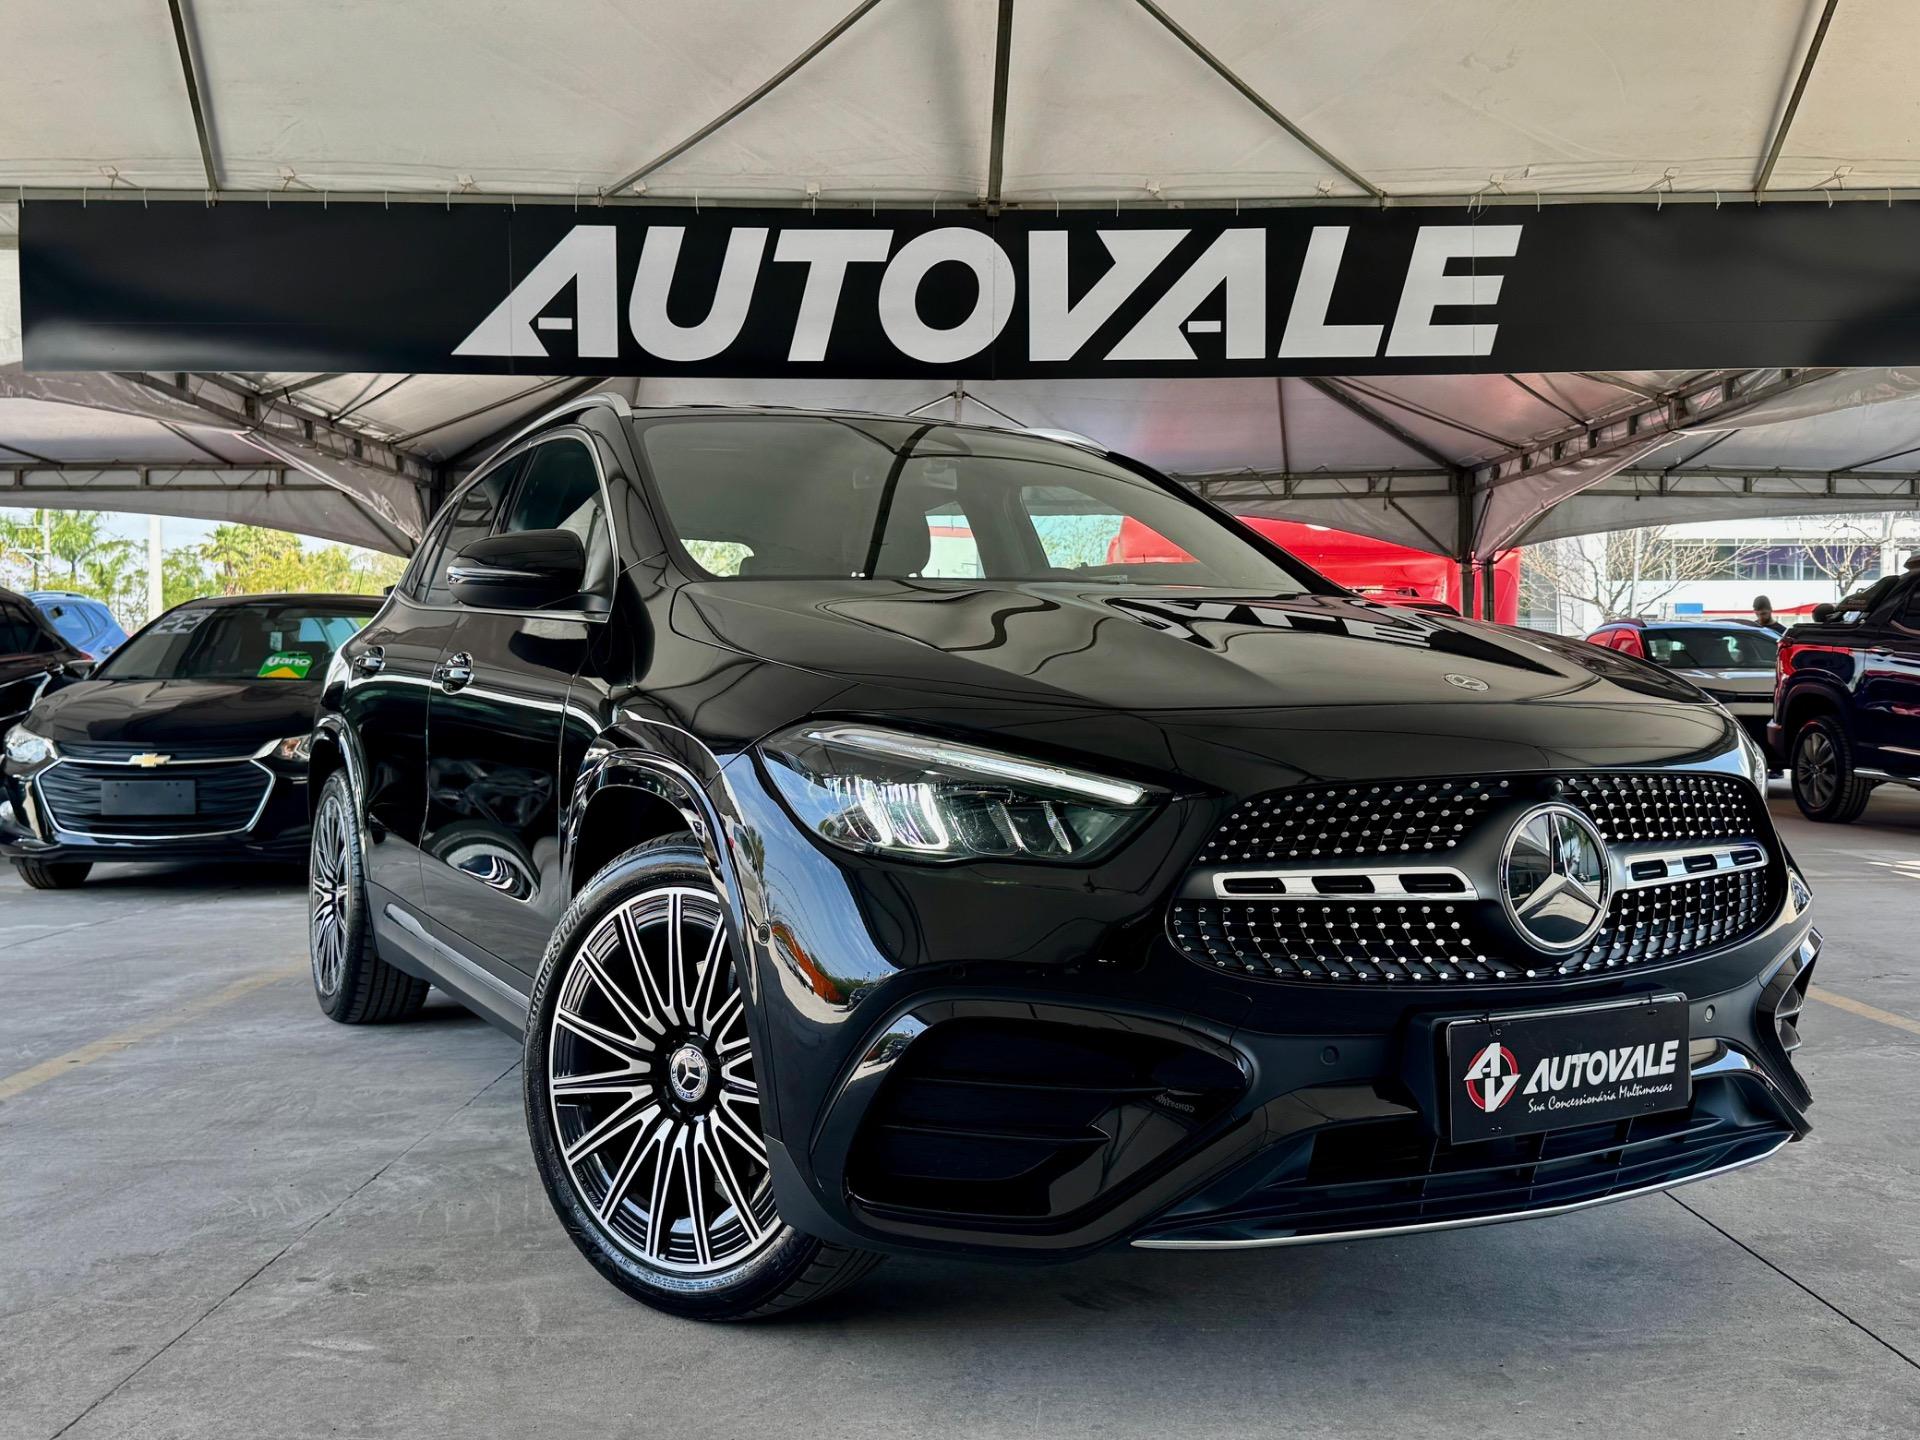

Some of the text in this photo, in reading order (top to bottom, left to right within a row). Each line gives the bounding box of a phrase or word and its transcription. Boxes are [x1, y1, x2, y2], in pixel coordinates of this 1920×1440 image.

[452, 225, 1522, 363] AUTOVALE
[1523, 1040, 1680, 1095] AUTOVALE
[1528, 1084, 1673, 1113] Sua Concessionária Multimarcas
